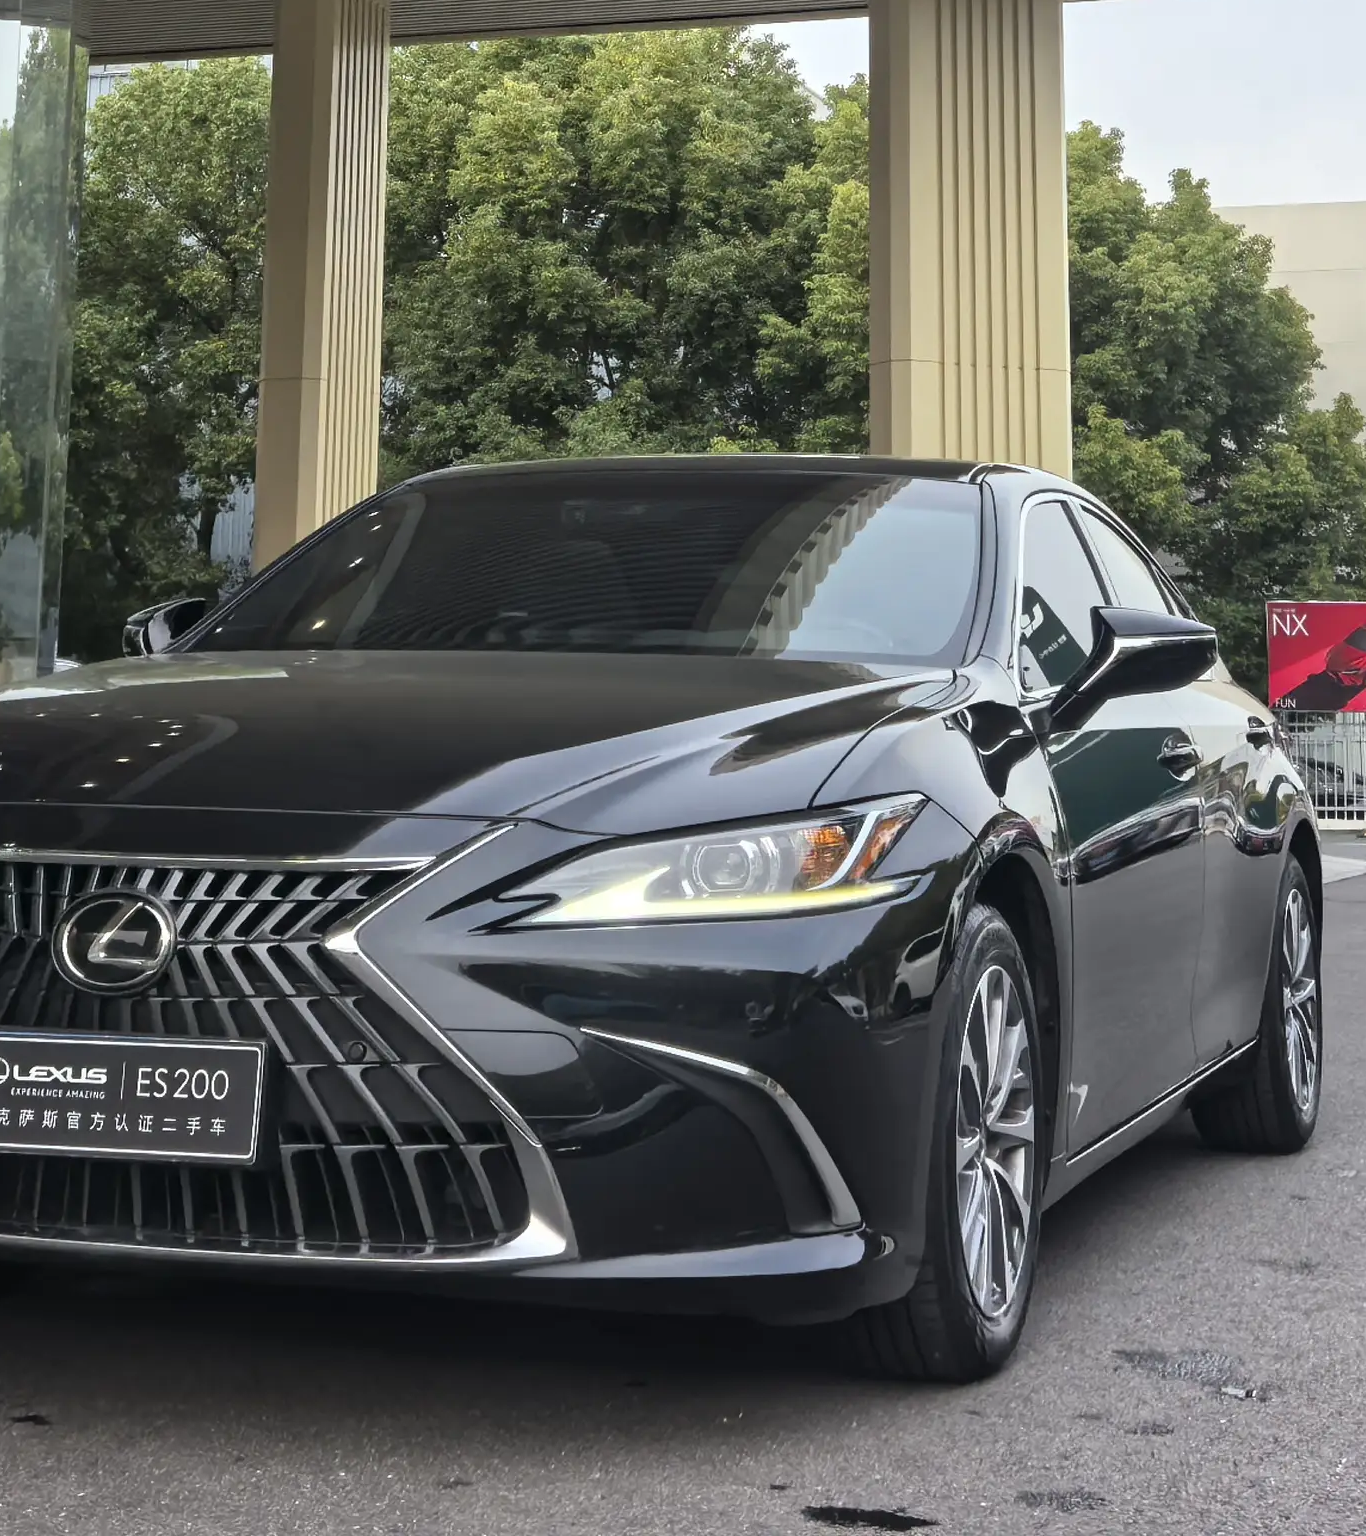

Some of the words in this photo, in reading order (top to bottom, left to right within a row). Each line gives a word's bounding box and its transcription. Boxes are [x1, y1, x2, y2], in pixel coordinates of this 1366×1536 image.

[1272, 613, 1310, 637] NX
[1275, 698, 1297, 709] FUN
[13, 1064, 108, 1085] LEXUS
[136, 1067, 230, 1101] ES200
[10, 1086, 63, 1098] EXPERIENCE
[65, 1089, 105, 1100] AMAZING
